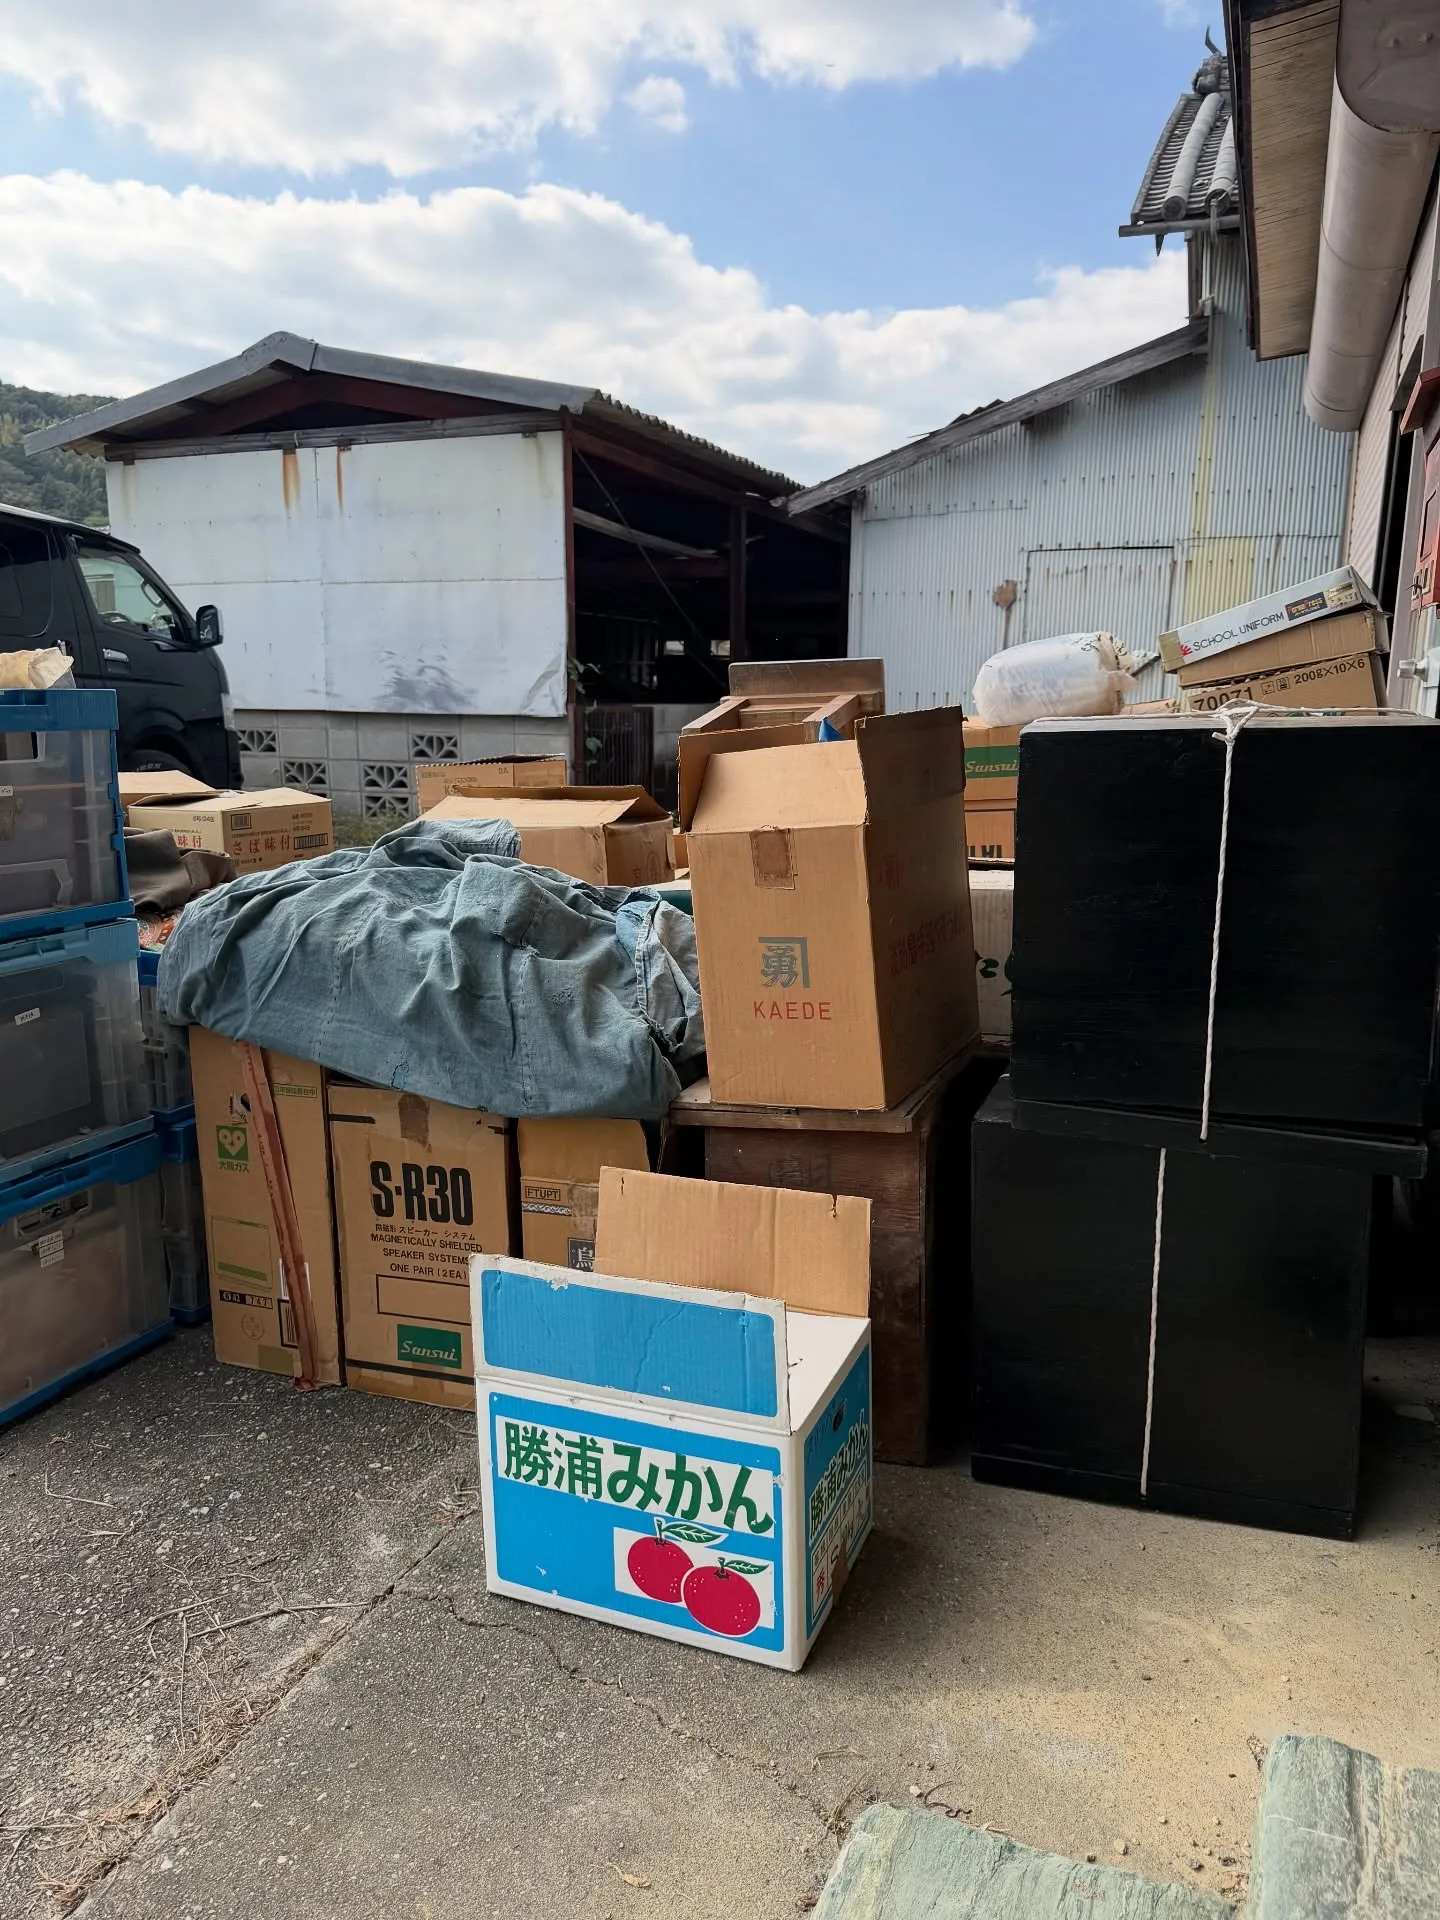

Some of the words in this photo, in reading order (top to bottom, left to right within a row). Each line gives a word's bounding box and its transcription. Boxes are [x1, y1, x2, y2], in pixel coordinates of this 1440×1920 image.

[1193, 630, 1238, 651] SCHOOL
[1238, 611, 1285, 634] UNIFORM
[966, 760, 1018, 773] Sansui
[232, 834, 291, 856] さば味付
[753, 1001, 832, 1020] KAEDE
[218, 1160, 250, 1174] 大阪ガス
[370, 1232, 437, 1248] MAGNETICALLY
[439, 1239, 483, 1253] SHIELDED
[399, 1225, 439, 1237] スピーカー
[444, 1229, 476, 1241] システム
[382, 1247, 425, 1261] SPEAKER
[428, 1252, 470, 1266] SYSTEMS
[389, 1262, 410, 1273] ONE
[413, 1264, 434, 1276] PAIR
[437, 1268, 467, 1280] (2EA)
[401, 1340, 458, 1361] Sansui
[503, 1421, 774, 1534] 勝浦みかん
[810, 1409, 869, 1538] 勝浦みかん
